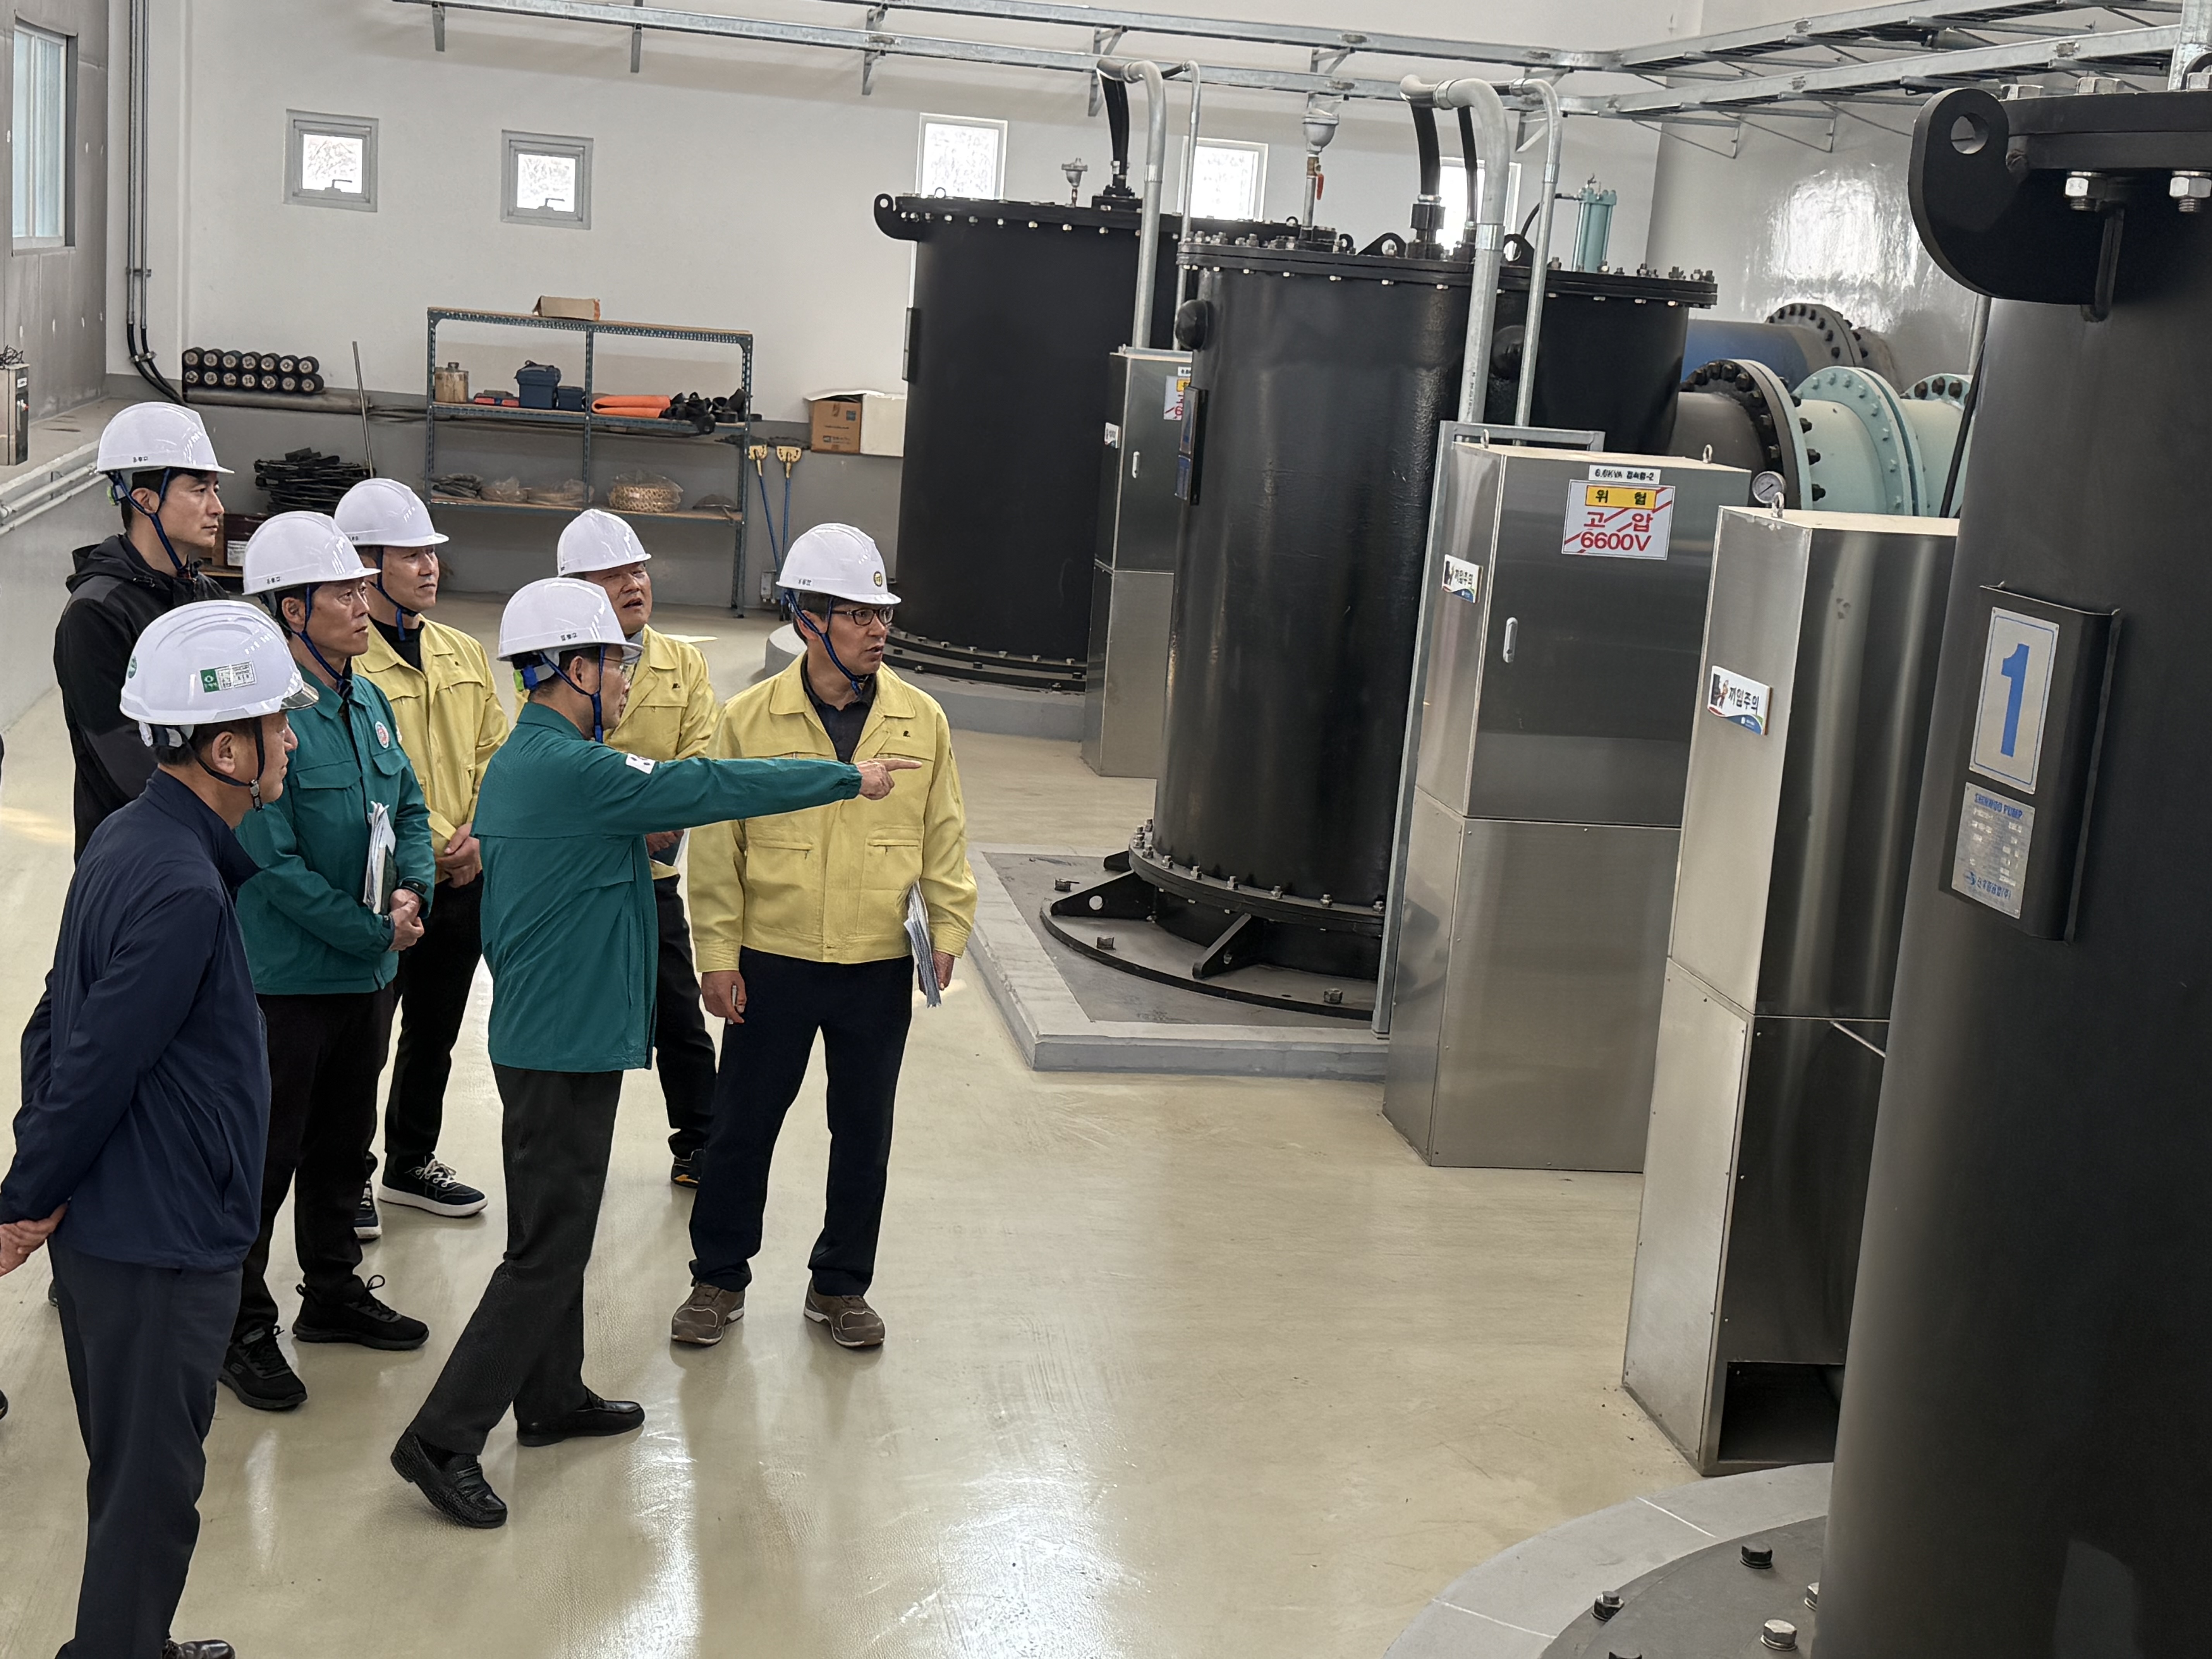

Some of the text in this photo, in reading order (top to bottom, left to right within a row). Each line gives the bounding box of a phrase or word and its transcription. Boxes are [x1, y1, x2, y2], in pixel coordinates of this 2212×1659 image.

[1595, 489, 1647, 505] 위 험
[1583, 512, 1654, 532] 고 압
[1580, 531, 1652, 551] 6600V
[1728, 687, 1759, 716] 끼임주의
[2001, 643, 2030, 757] 1
